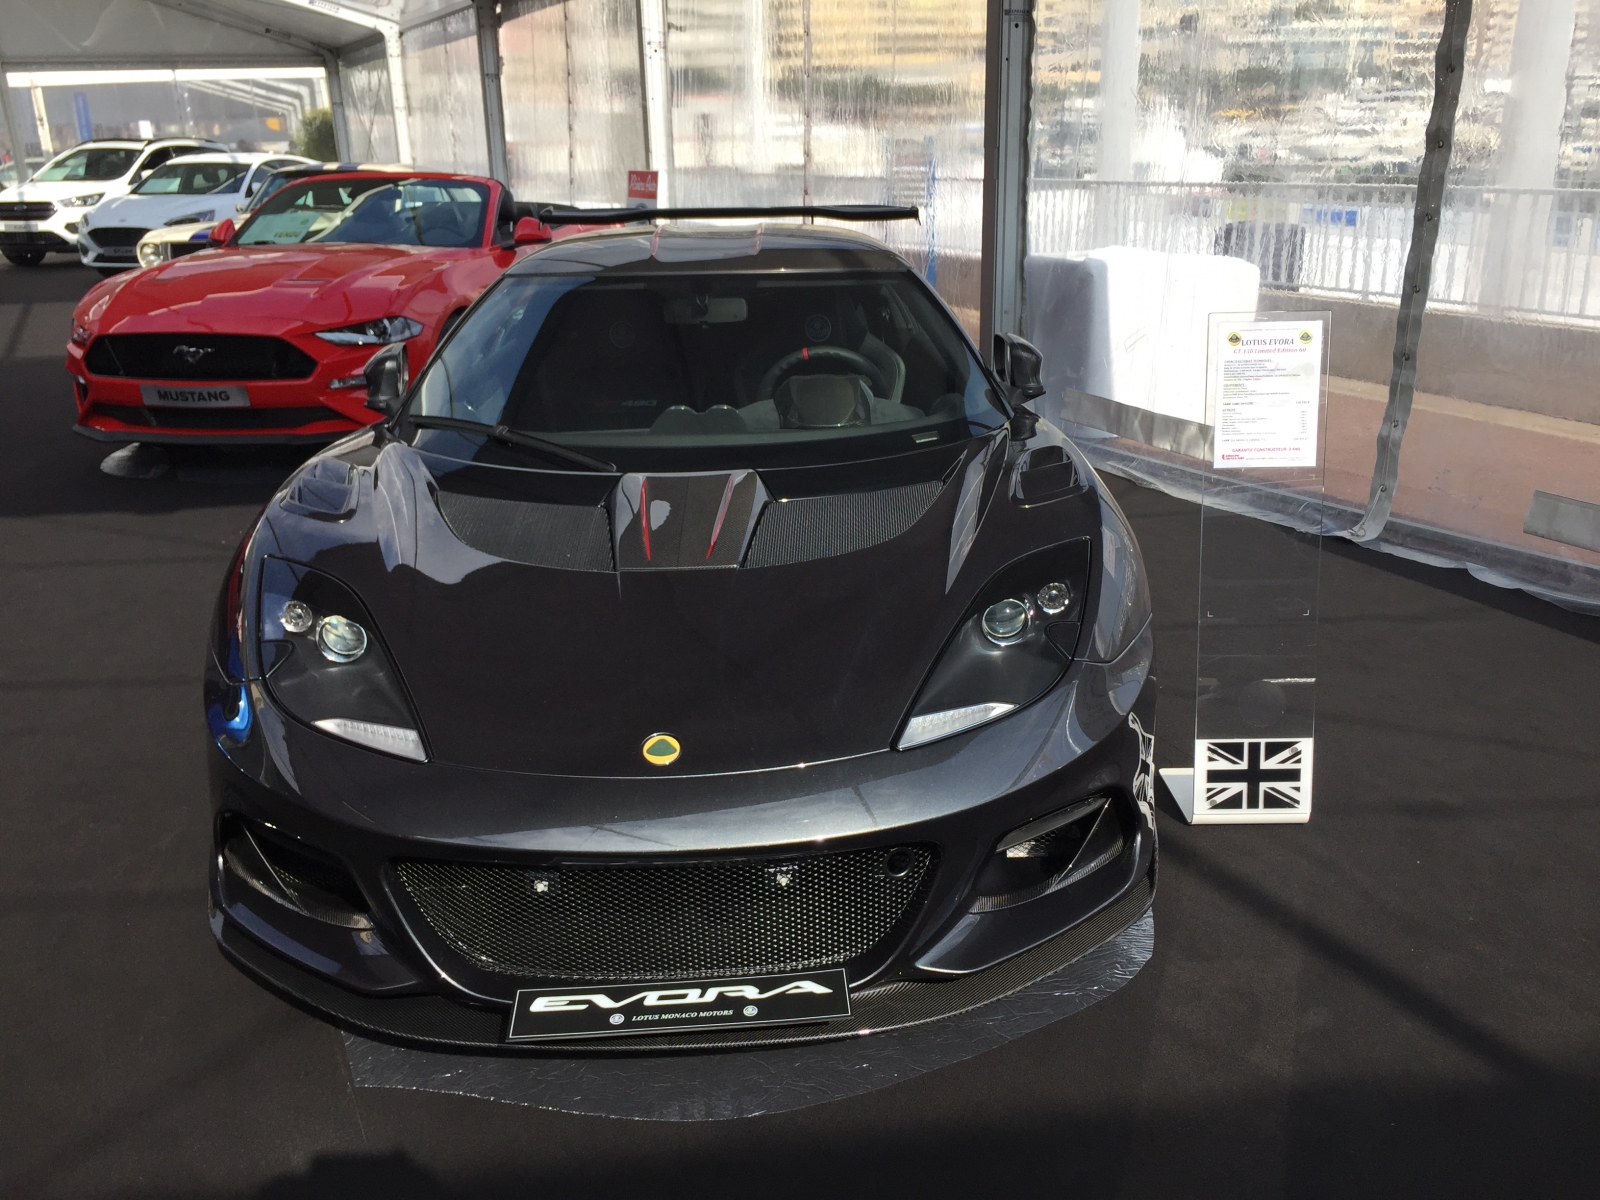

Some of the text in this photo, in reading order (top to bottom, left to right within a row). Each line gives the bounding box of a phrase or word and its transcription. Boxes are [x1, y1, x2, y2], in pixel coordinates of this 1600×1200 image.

[1268, 338, 1295, 346] EVORA
[157, 389, 231, 402] MUSTANG
[529, 980, 834, 1013] EVORA
[660, 1012, 698, 1020] MONACO
[698, 1009, 734, 1017] MOTORS
